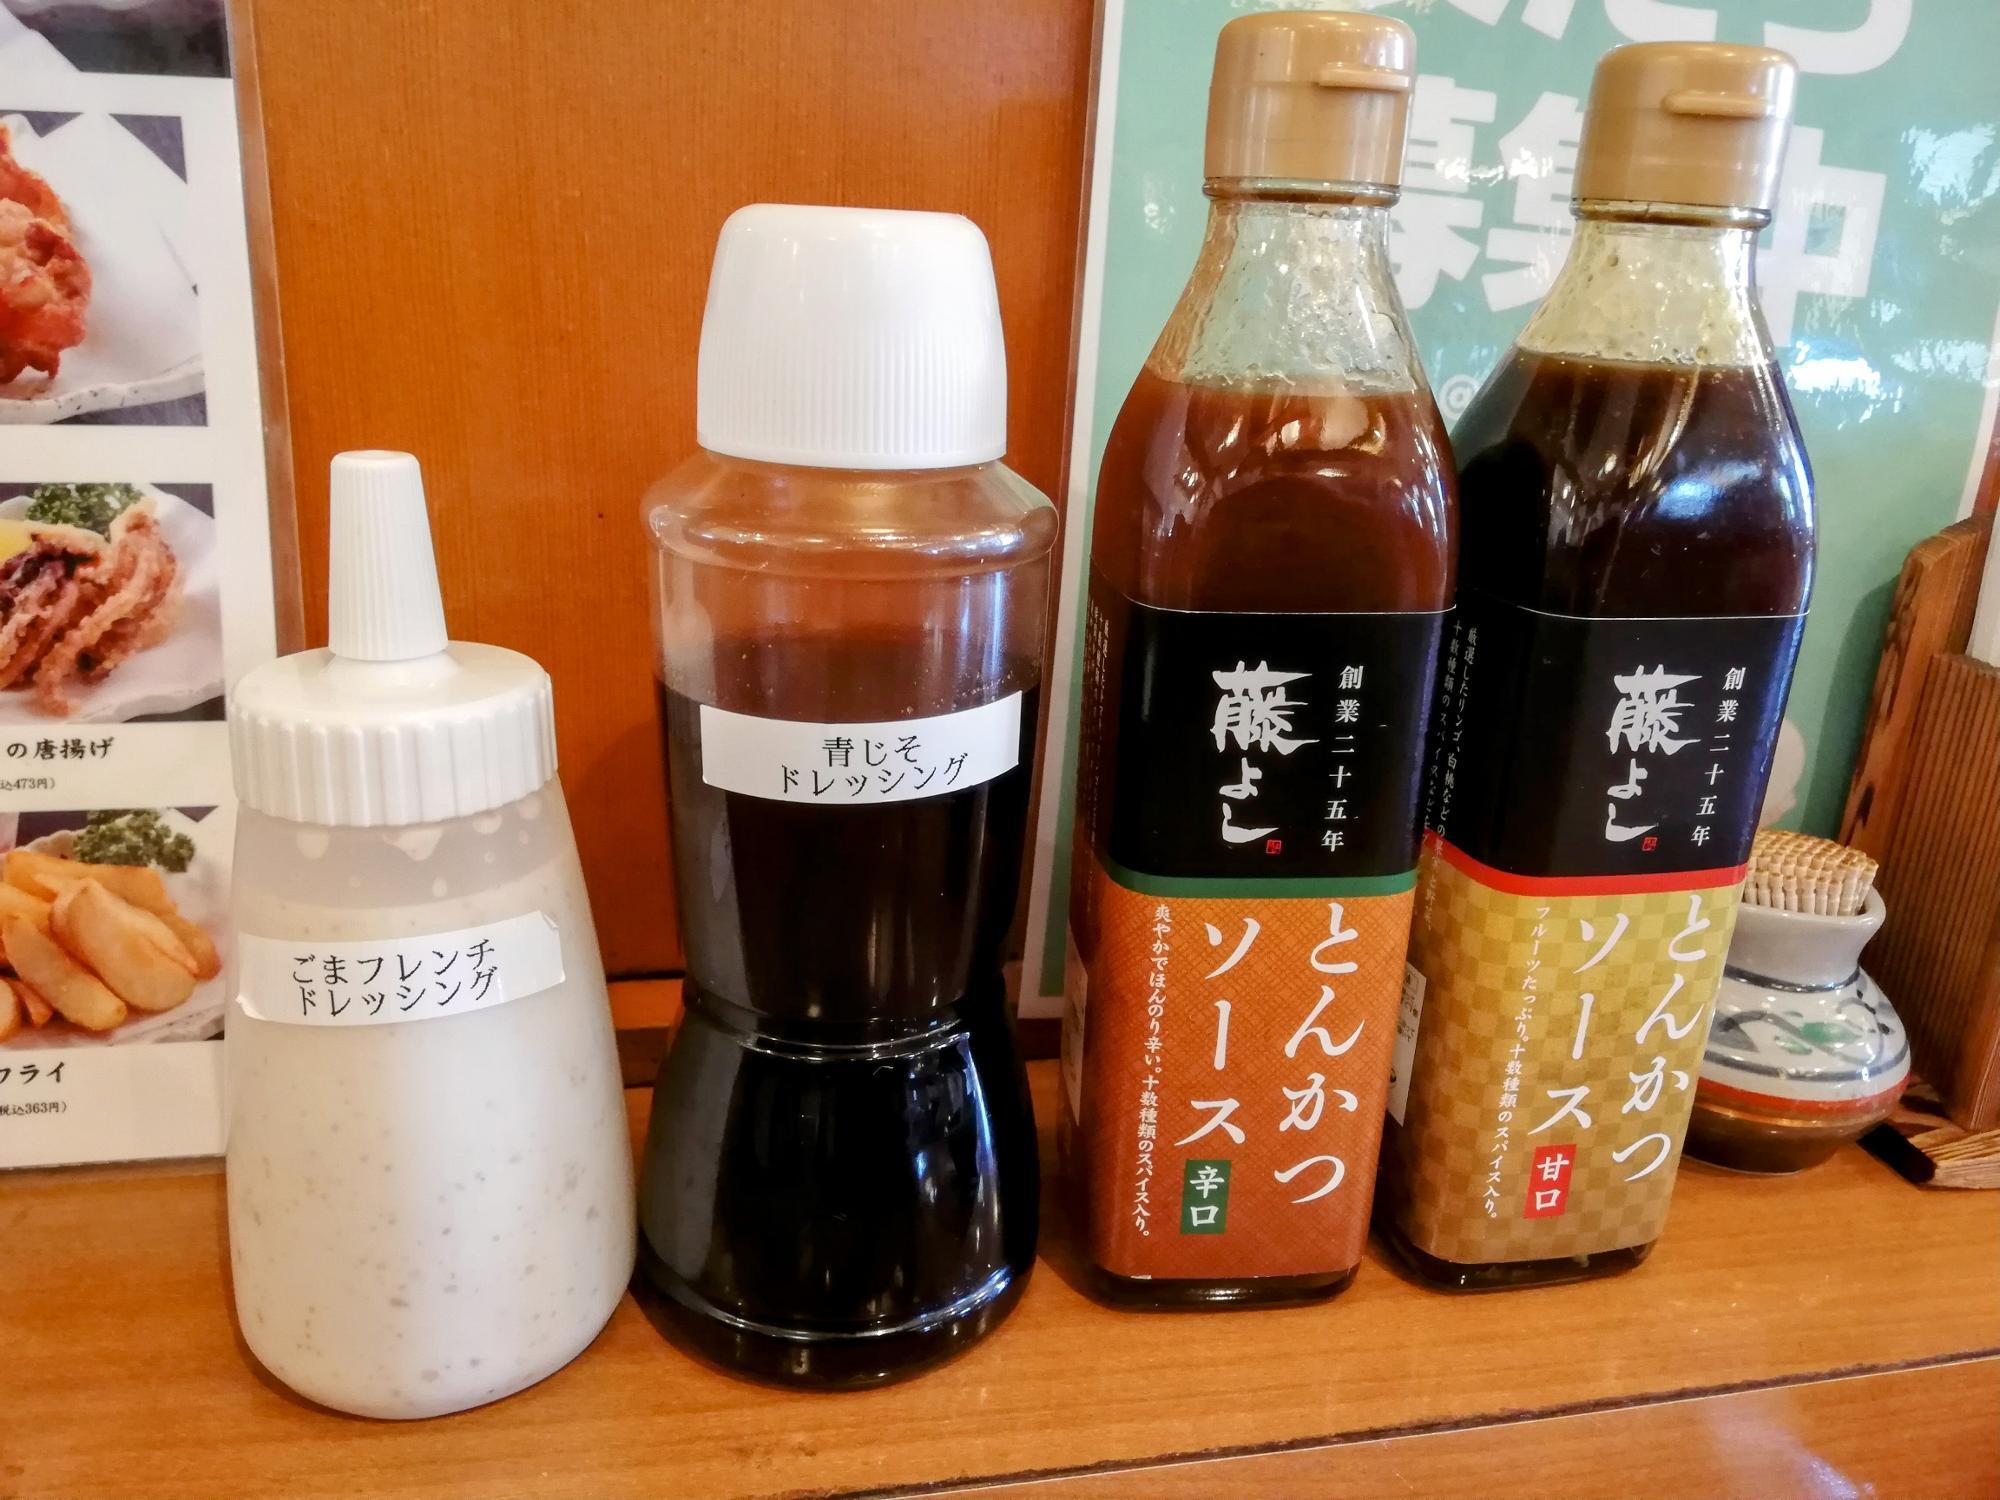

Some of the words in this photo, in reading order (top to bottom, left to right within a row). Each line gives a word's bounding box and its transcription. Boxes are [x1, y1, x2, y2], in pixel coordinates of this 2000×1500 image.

[7, 737, 115, 760] の唐揚げ
[781, 753, 968, 797] ドレッシング
[822, 735, 921, 767] 青じそ
[1210, 660, 1320, 844] 藤よし
[1321, 665, 1364, 852] 創業二十五年
[1605, 664, 1703, 842] 藤よし
[1690, 667, 1746, 847] 創業二十五年
[292, 939, 495, 985] ごまフレンチ
[299, 966, 498, 1017] ドレッシング
[1174, 917, 1261, 1147] ソース
[1527, 913, 1630, 1136] ソース
[1612, 894, 1710, 1182] とんかつ
[1274, 902, 1366, 1204] とんかつ
[1189, 1165, 1225, 1227] 辛口
[1535, 1153, 1569, 1211] 甘口
